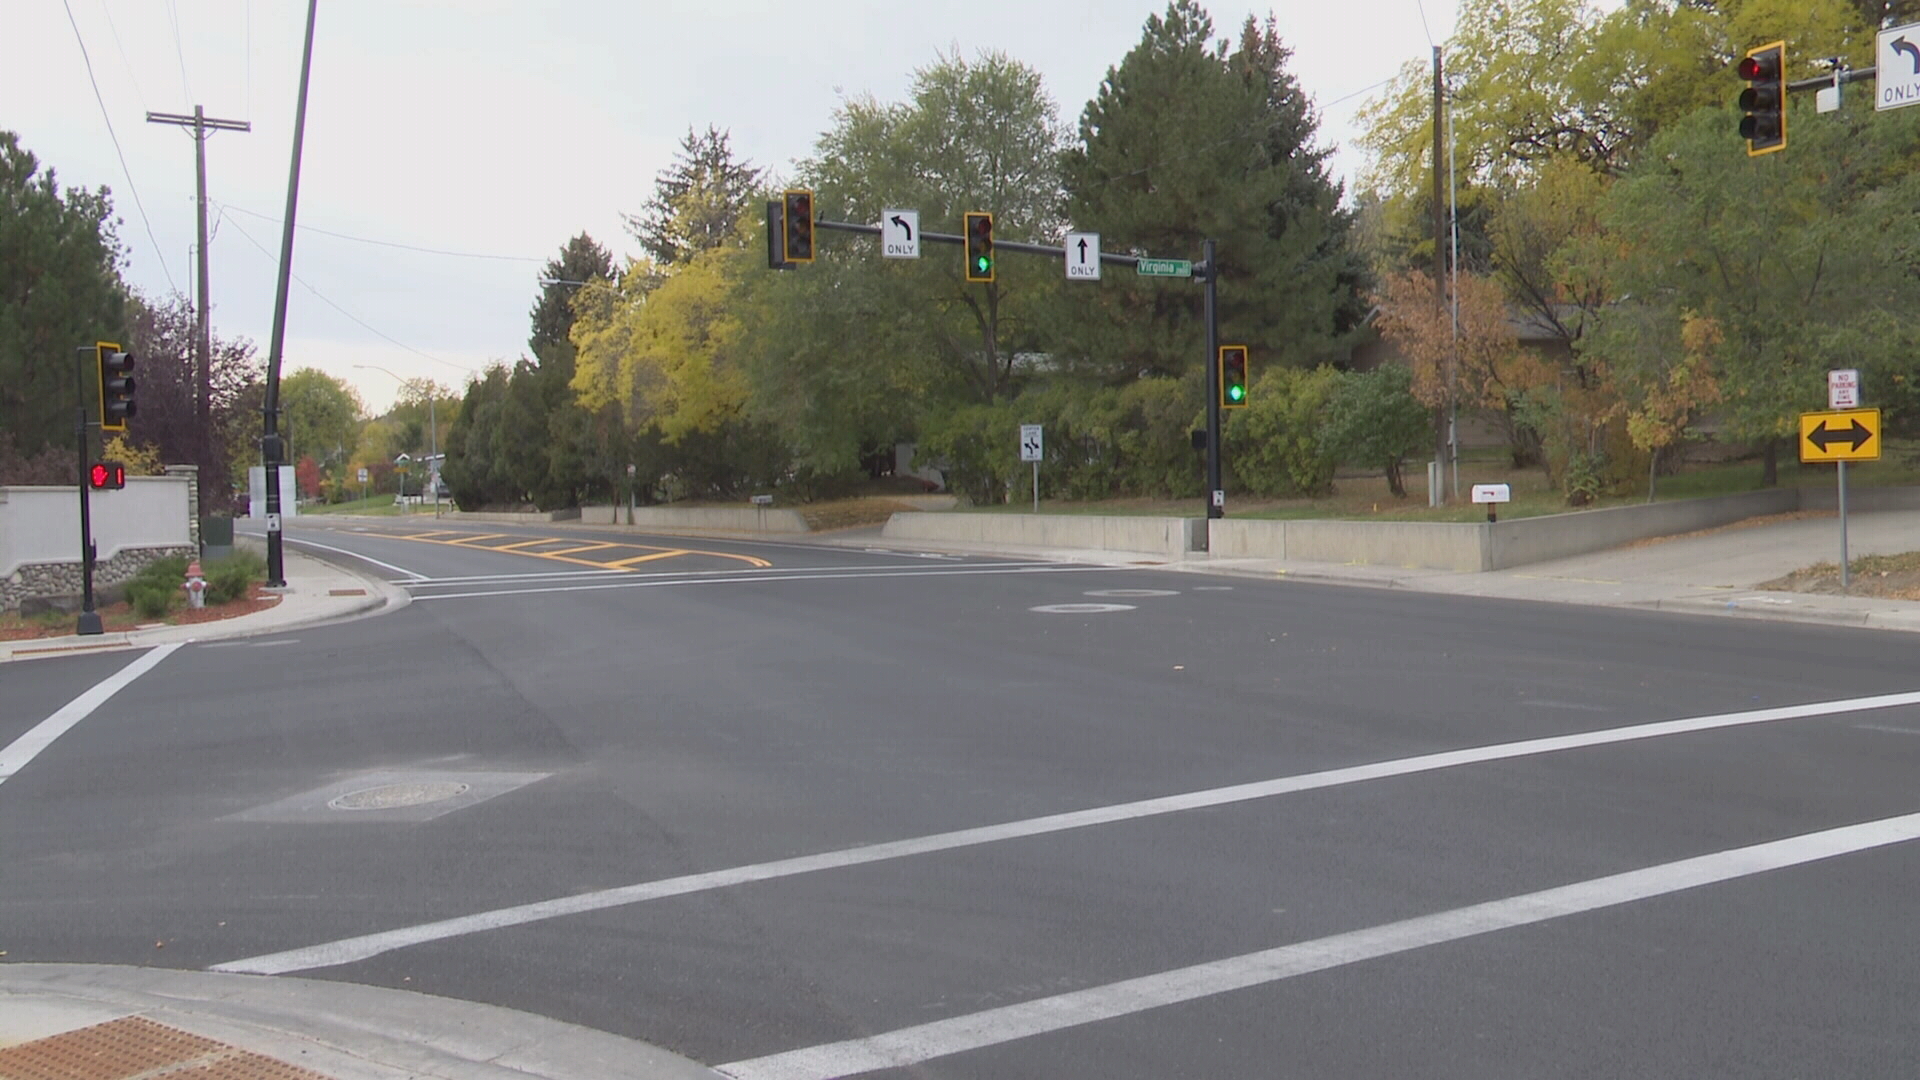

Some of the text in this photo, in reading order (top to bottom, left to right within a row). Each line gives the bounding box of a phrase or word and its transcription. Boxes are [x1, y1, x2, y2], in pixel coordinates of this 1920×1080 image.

[1884, 83, 1920, 103] ONLY
[887, 244, 914, 255] ONLY
[1071, 266, 1095, 276] ONLY
[1140, 260, 1175, 275] Virginia
